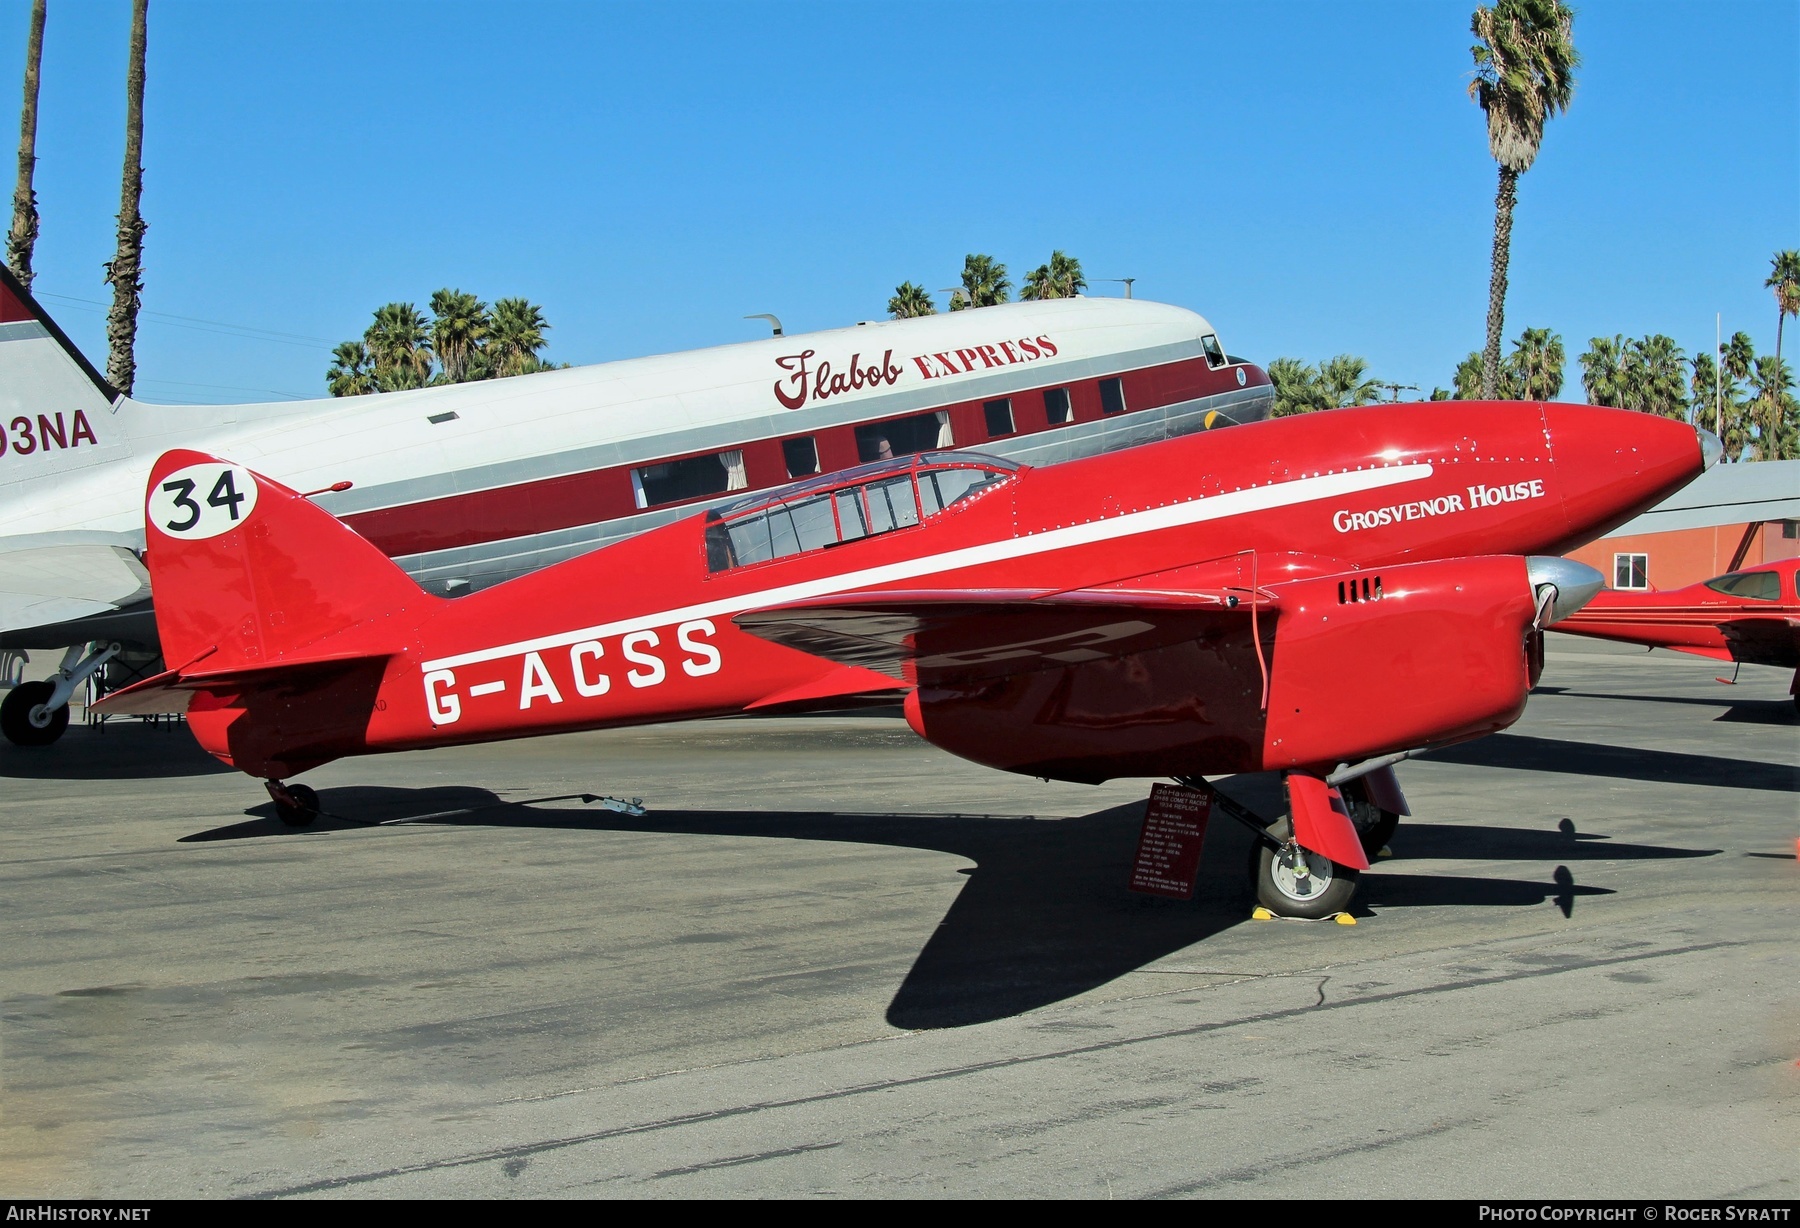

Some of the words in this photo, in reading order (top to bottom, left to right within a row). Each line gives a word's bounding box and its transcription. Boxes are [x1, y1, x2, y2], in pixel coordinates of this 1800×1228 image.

[774, 349, 903, 410] Flabob
[911, 334, 1058, 380] EXPRESS
[0, 409, 97, 458] 3NA
[162, 469, 245, 532] 34
[1332, 494, 1465, 533] GROSVENOR
[1466, 479, 1546, 510] HOUSE
[423, 619, 722, 726] G-ACSS
